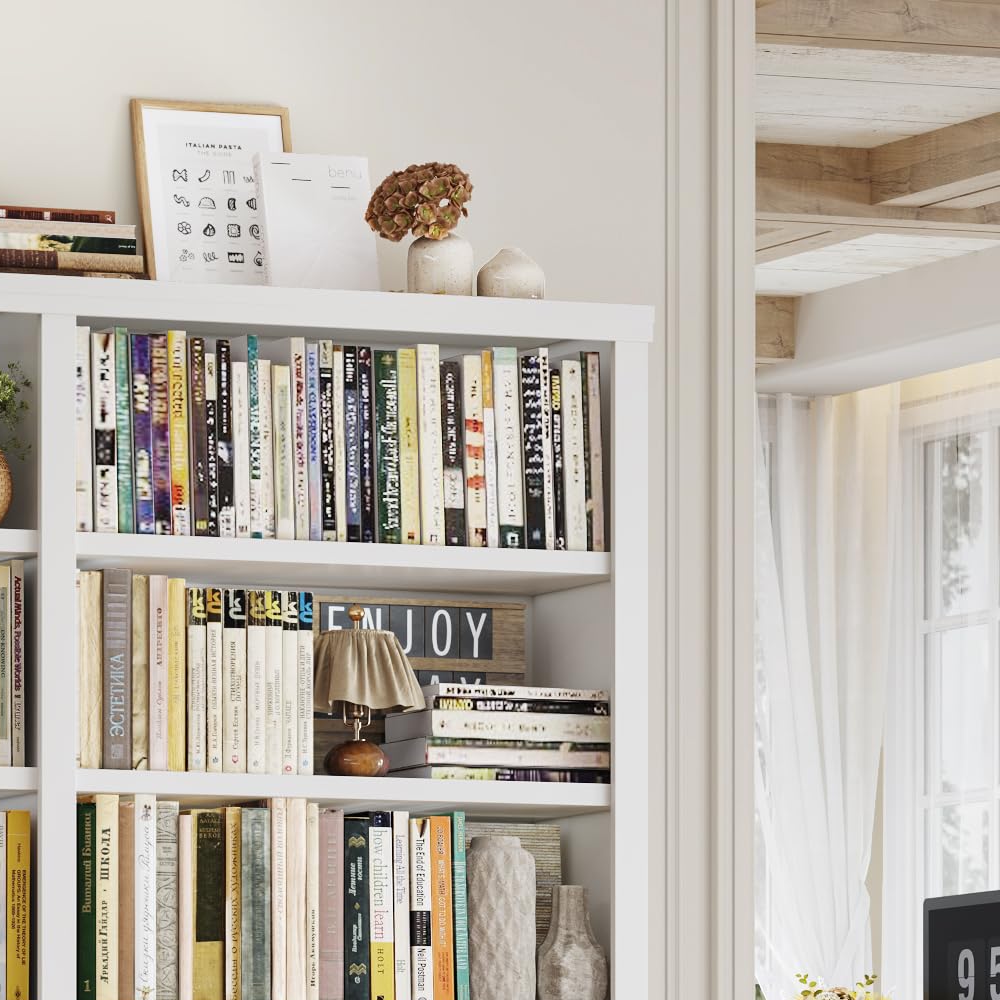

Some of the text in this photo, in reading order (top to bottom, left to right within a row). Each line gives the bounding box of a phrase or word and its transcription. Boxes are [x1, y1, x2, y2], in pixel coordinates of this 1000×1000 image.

[328, 606, 487, 659] ENJOY
[109, 653, 124, 737] ЭСТЕТИКА
[229, 823, 239, 893] художниках
[415, 839, 426, 851] The
[415, 852, 426, 864] End
[371, 829, 388, 974] how children learn HOLT
[415, 873, 426, 906] Education
[229, 898, 239, 942] русских
[415, 948, 426, 961] Neil
[229, 960, 239, 1000] Беседы
[415, 962, 426, 991] Postman
